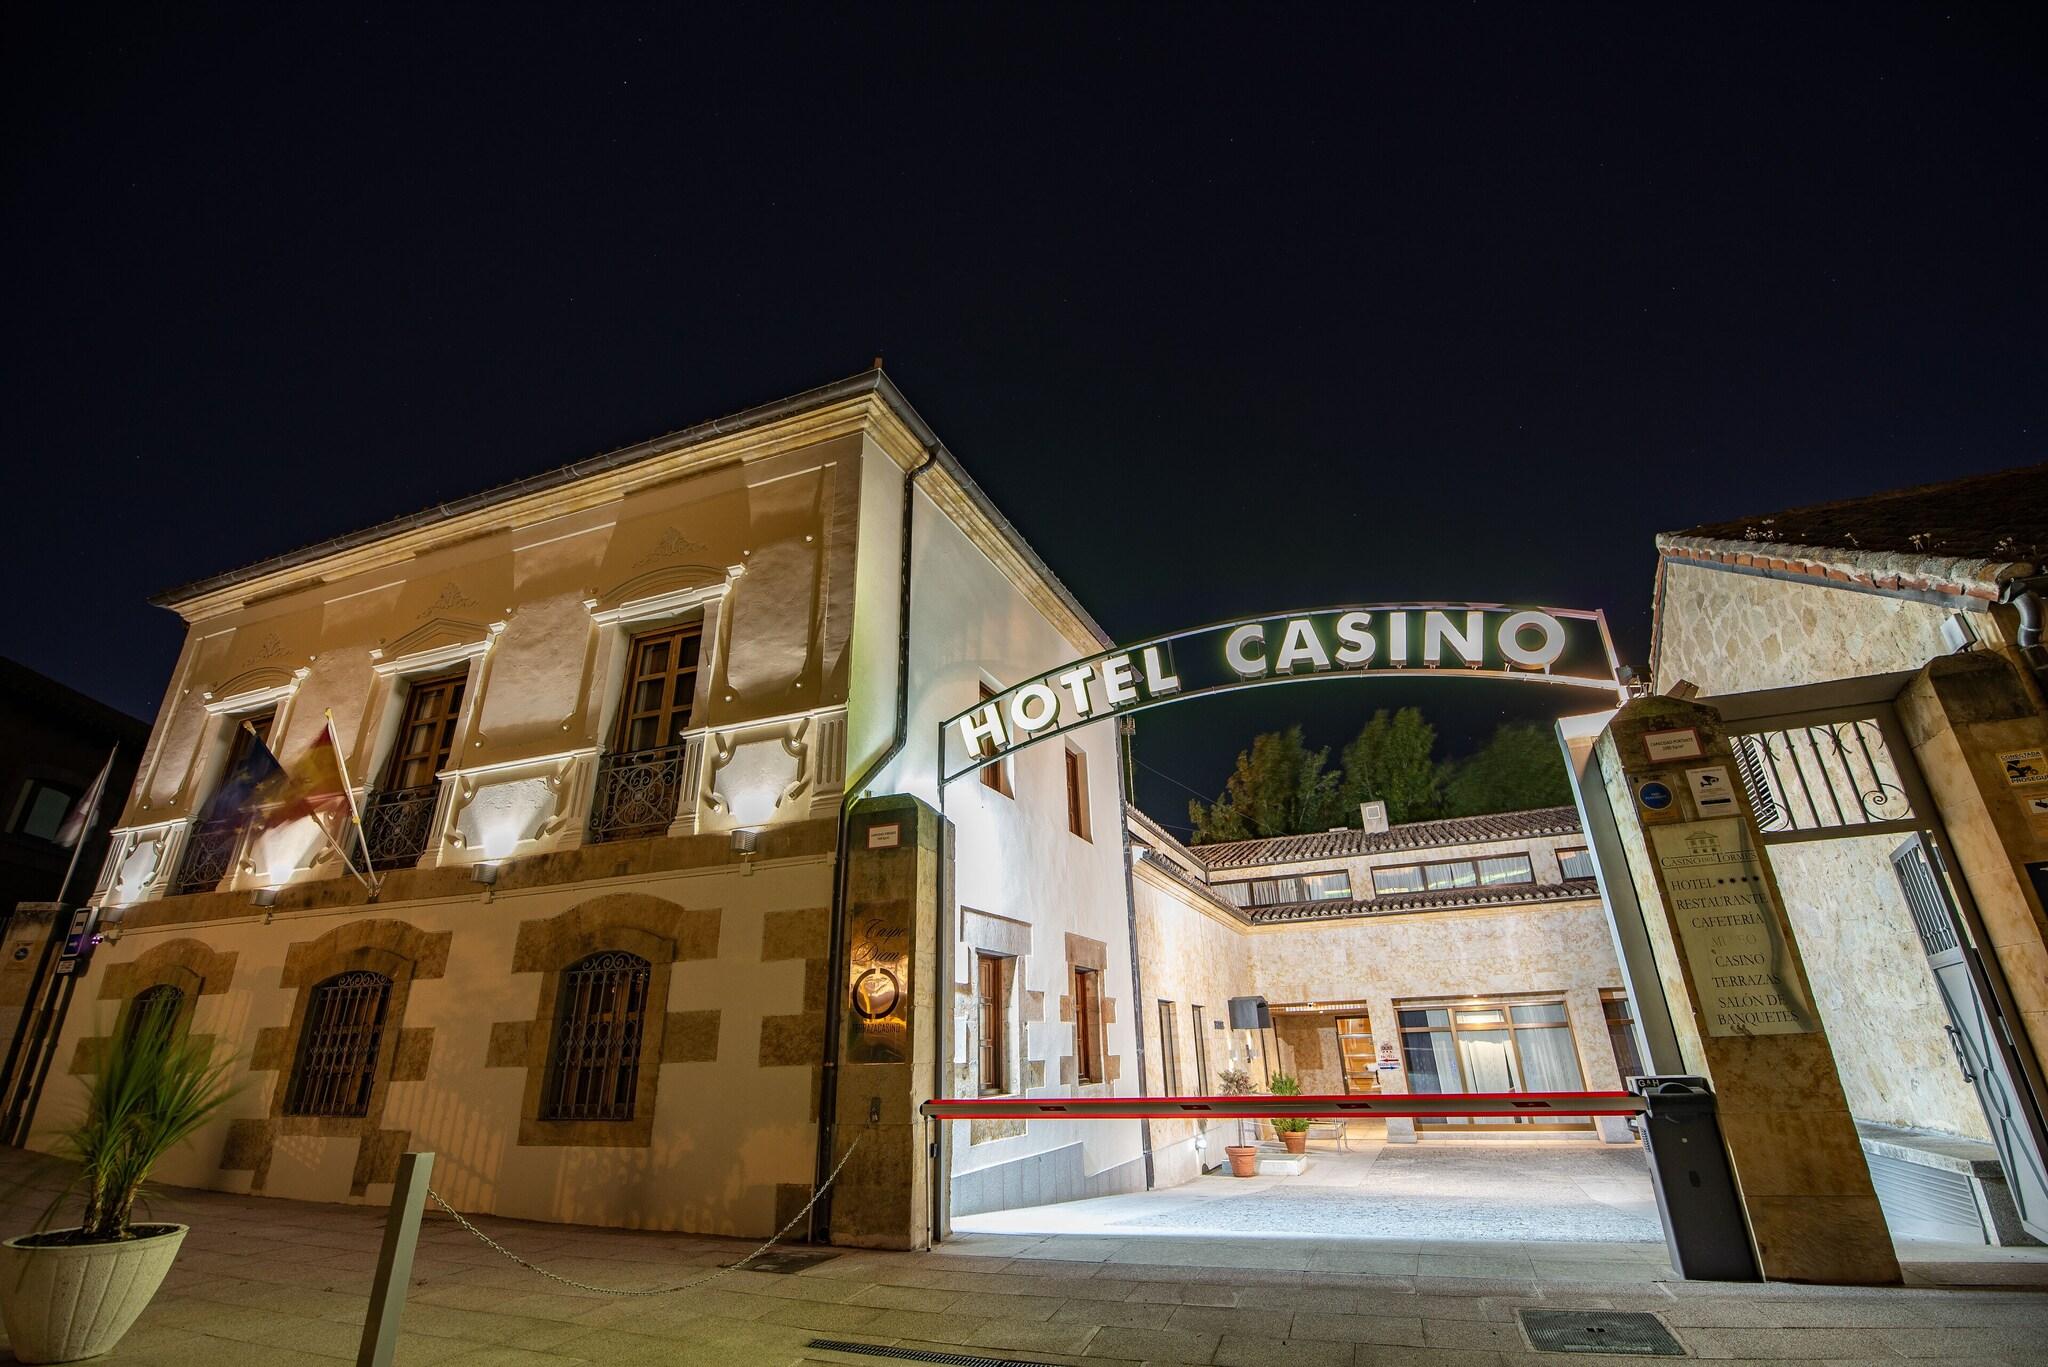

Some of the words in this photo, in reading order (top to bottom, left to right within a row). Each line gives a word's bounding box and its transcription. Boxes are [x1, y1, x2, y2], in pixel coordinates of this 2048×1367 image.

[958, 645, 1180, 760] HOTEL
[1224, 610, 1567, 677] CASINO
[1671, 878, 1717, 891] HOTEL
[1677, 894, 1768, 910] RESTAURANTE
[1692, 912, 1764, 928] CAFETERÍA
[1715, 952, 1765, 968] CASINO
[1712, 974, 1783, 988] TERRAZAS
[1719, 993, 1764, 1008] SALÓN
[1766, 994, 1785, 1006] DE
[1717, 1011, 1800, 1026] BANQUETES
